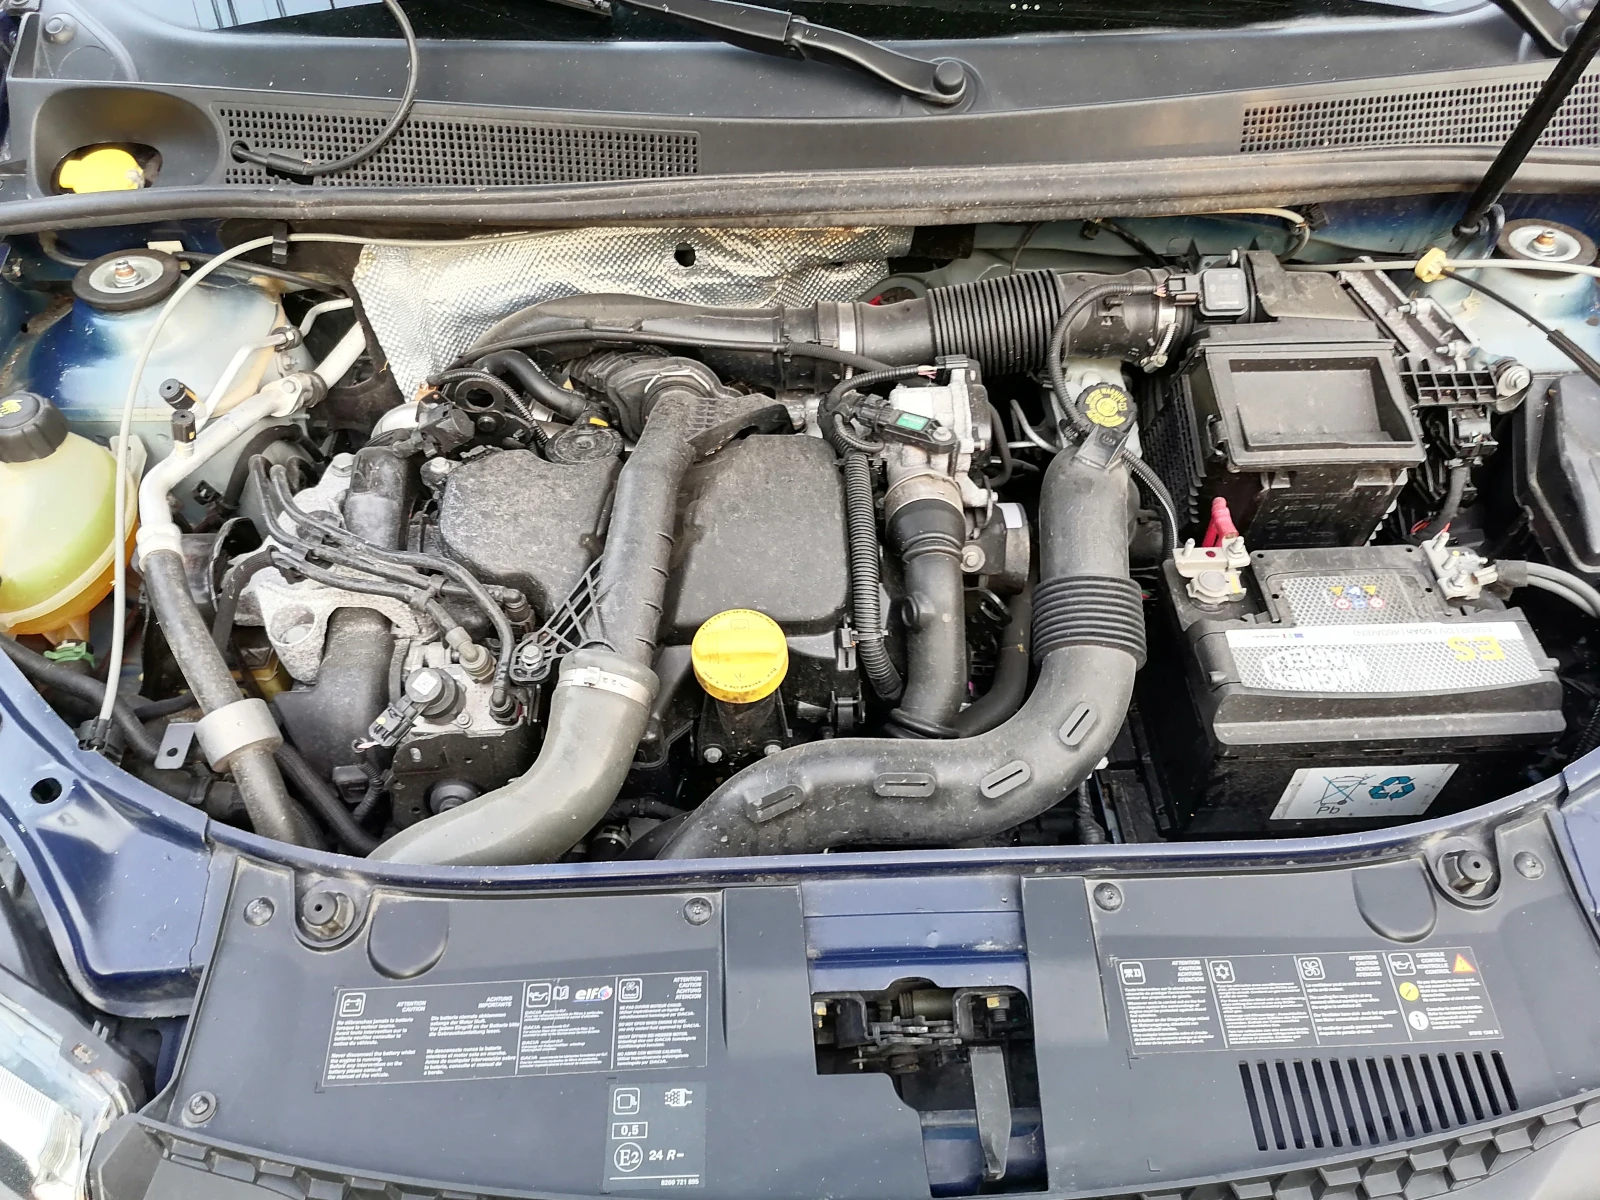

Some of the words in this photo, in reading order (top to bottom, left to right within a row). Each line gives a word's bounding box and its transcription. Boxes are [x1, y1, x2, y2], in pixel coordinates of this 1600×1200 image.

[1448, 636, 1505, 661] ES
[1316, 806, 1340, 814] Pb
[620, 1125, 639, 1136] 0,5
[619, 1149, 640, 1166] E2
[648, 1150, 663, 1161] 24
